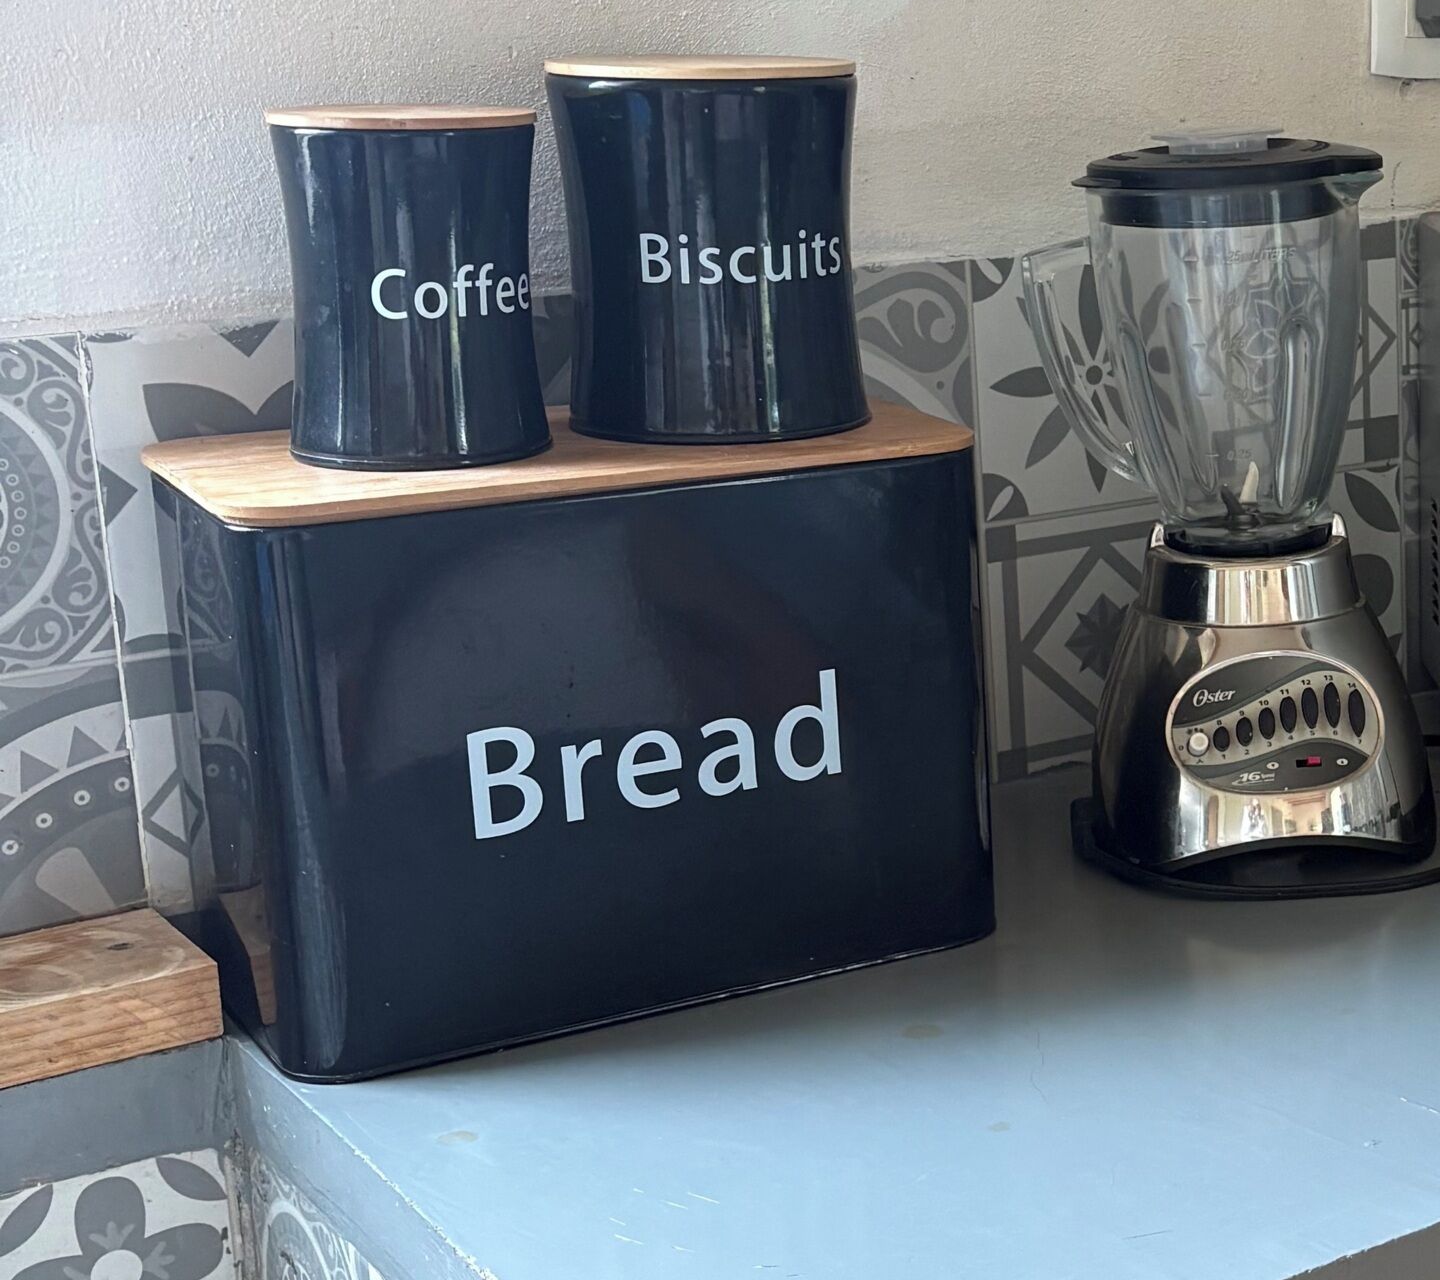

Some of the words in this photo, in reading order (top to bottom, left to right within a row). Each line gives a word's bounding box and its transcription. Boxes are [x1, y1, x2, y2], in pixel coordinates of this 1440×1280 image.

[639, 229, 842, 284] Biscuits
[370, 263, 530, 320] Coffee
[1192, 688, 1236, 707] Oster
[466, 668, 842, 840] Bread
[1239, 770, 1261, 782] 16
